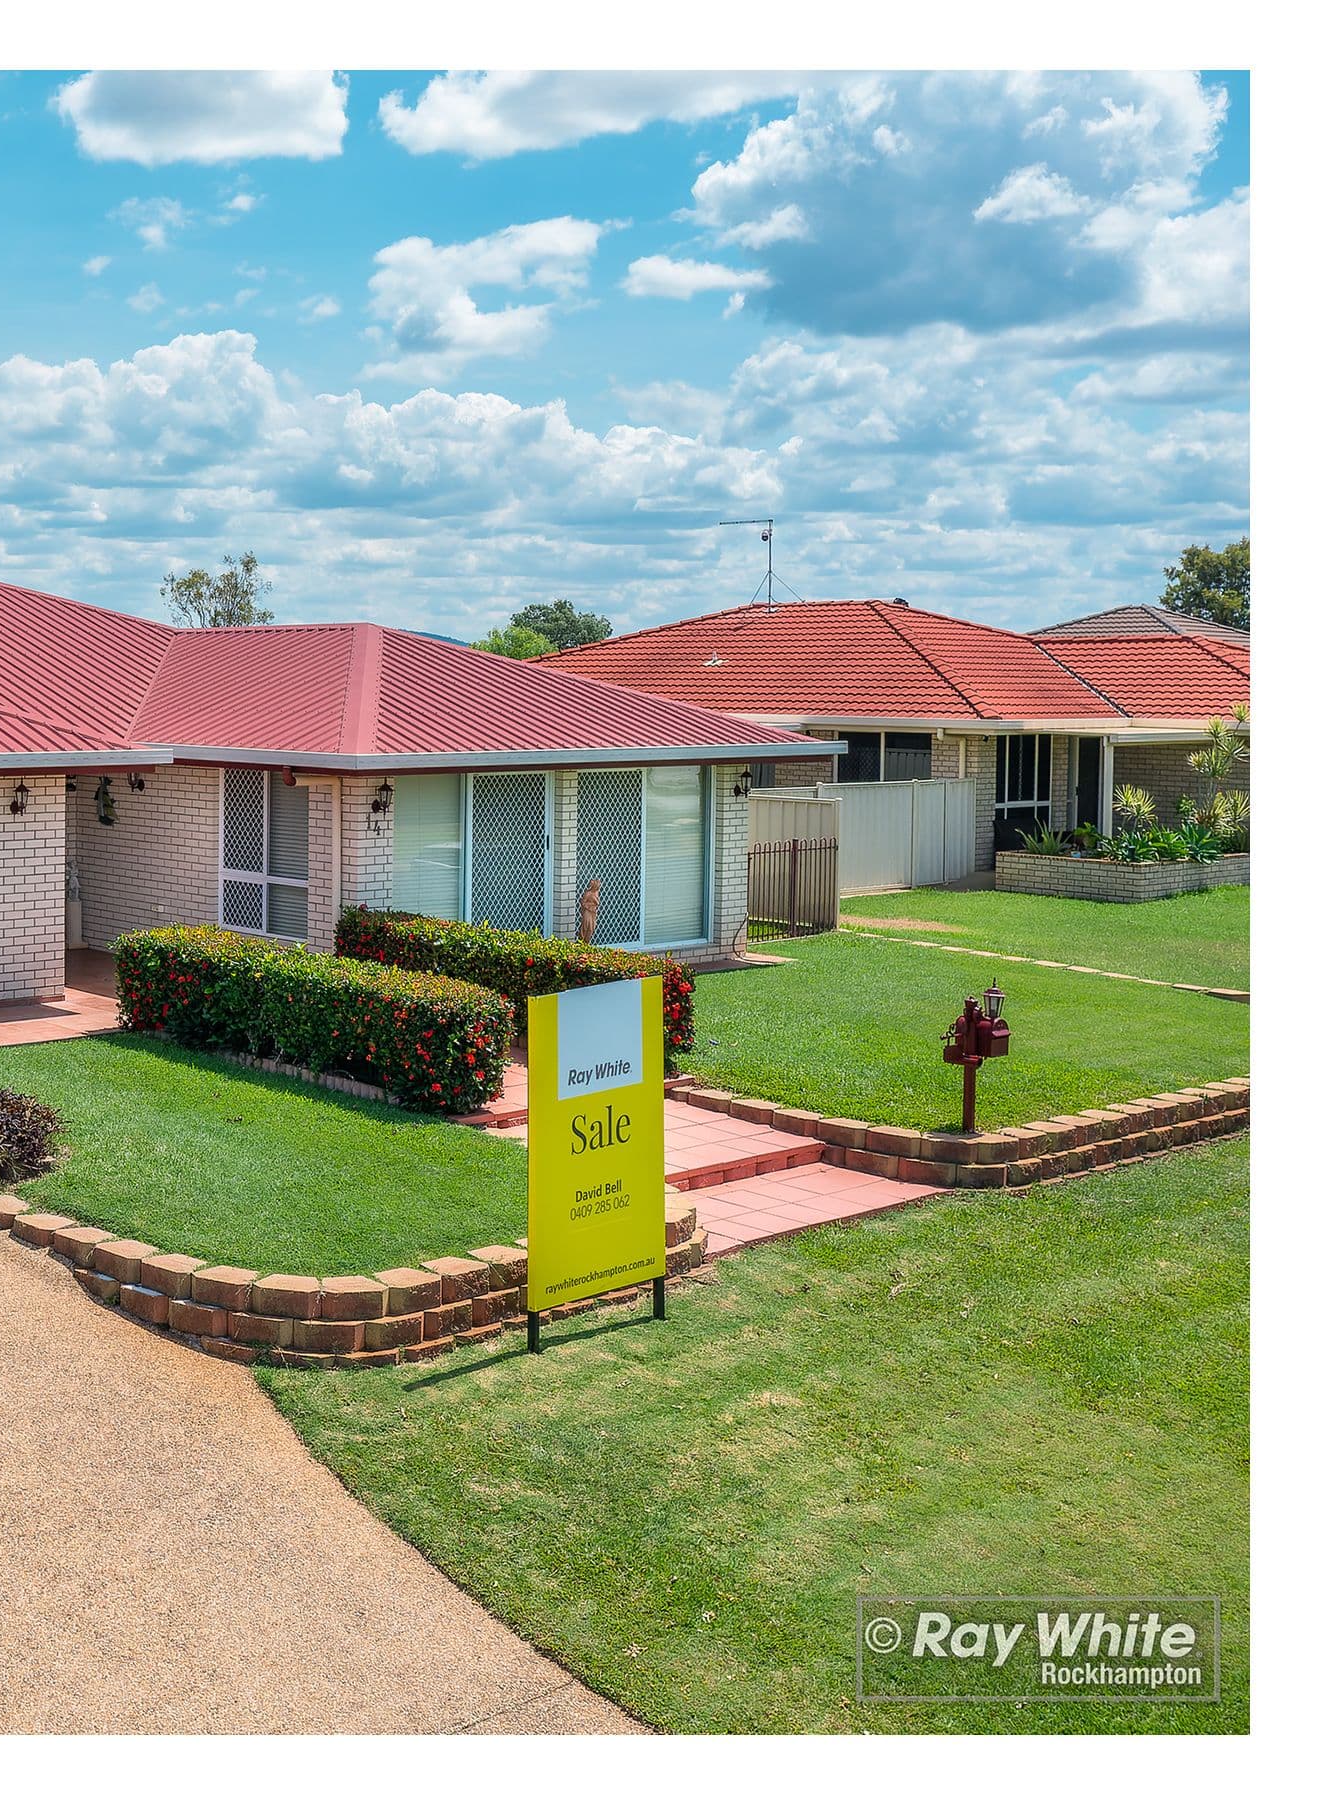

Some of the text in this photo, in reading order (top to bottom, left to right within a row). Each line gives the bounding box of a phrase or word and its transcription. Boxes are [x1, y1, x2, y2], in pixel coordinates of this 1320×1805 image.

[568, 1059, 631, 1086] Ray White
[571, 1104, 631, 1155] Sale
[575, 1179, 622, 1203] David Bell
[570, 1194, 630, 1221] 0409 285 062
[545, 1257, 655, 1295] raywhiterockhampton.com.au
